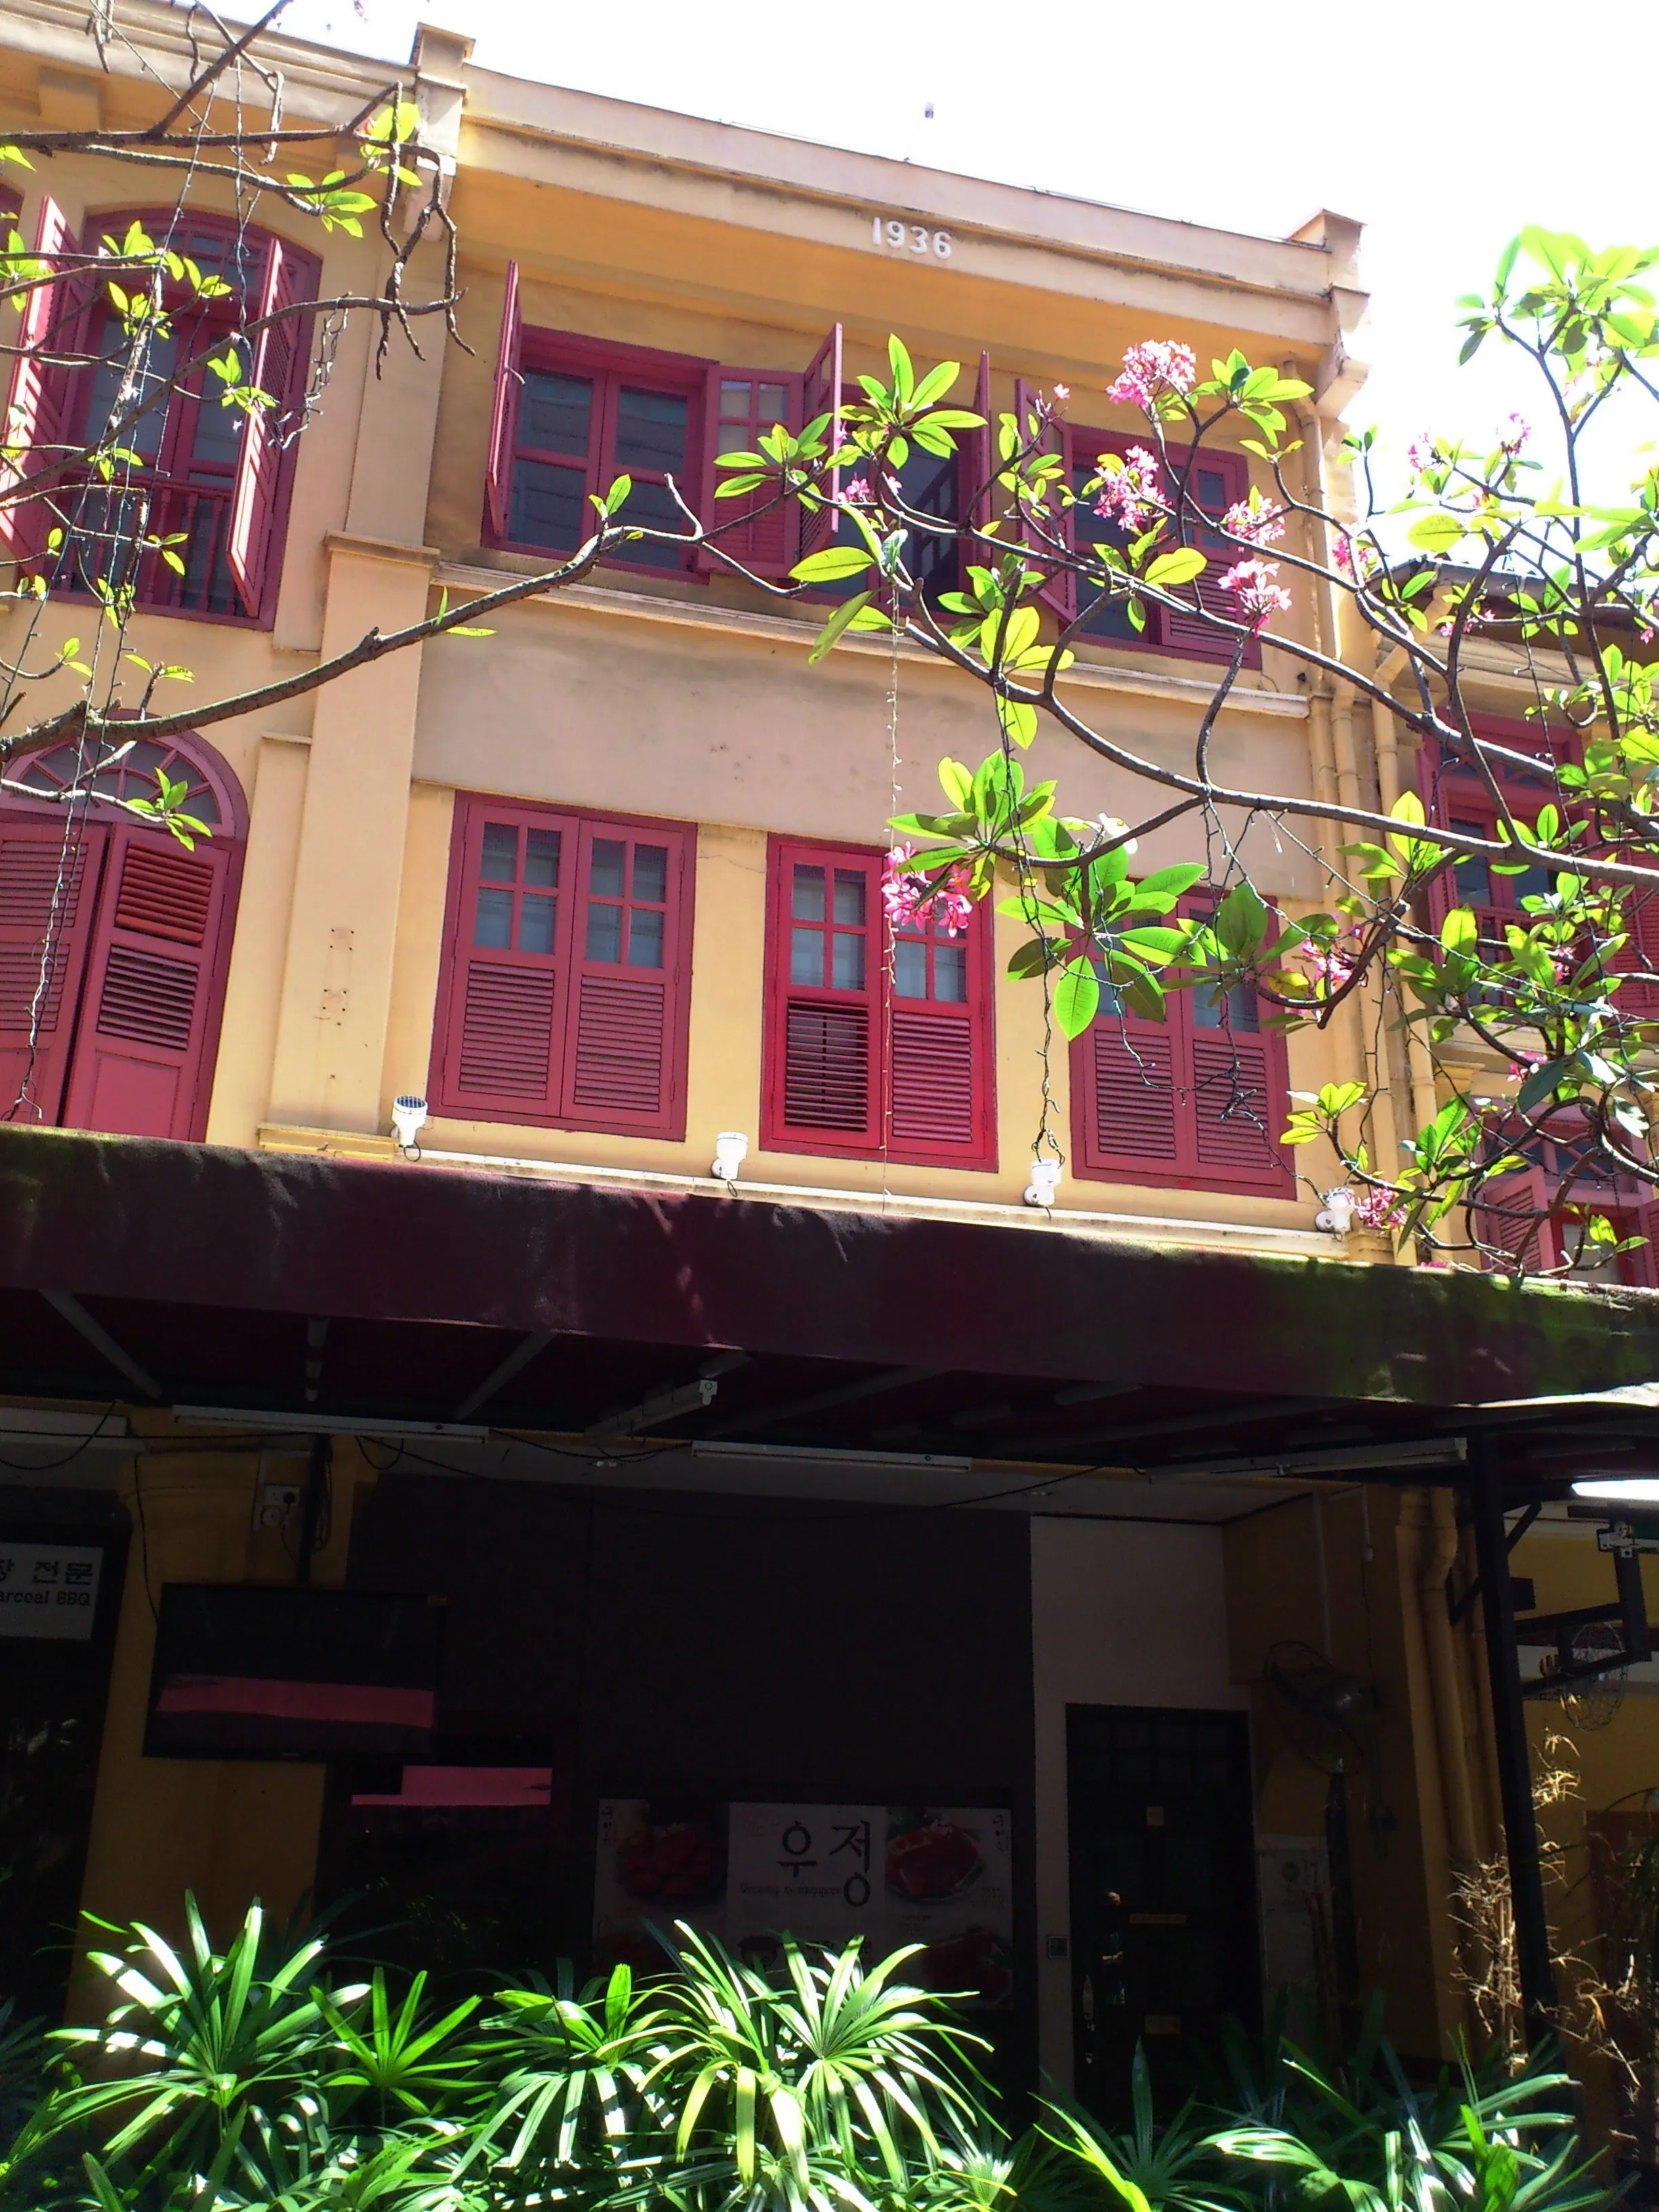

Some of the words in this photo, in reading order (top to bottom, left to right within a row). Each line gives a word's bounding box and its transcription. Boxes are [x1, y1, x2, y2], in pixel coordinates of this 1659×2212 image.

[871, 216, 953, 260] 1936
[33, 1560, 94, 1585] 전문
[56, 1591, 91, 1606] BBQ
[777, 1819, 871, 1907] 우정
